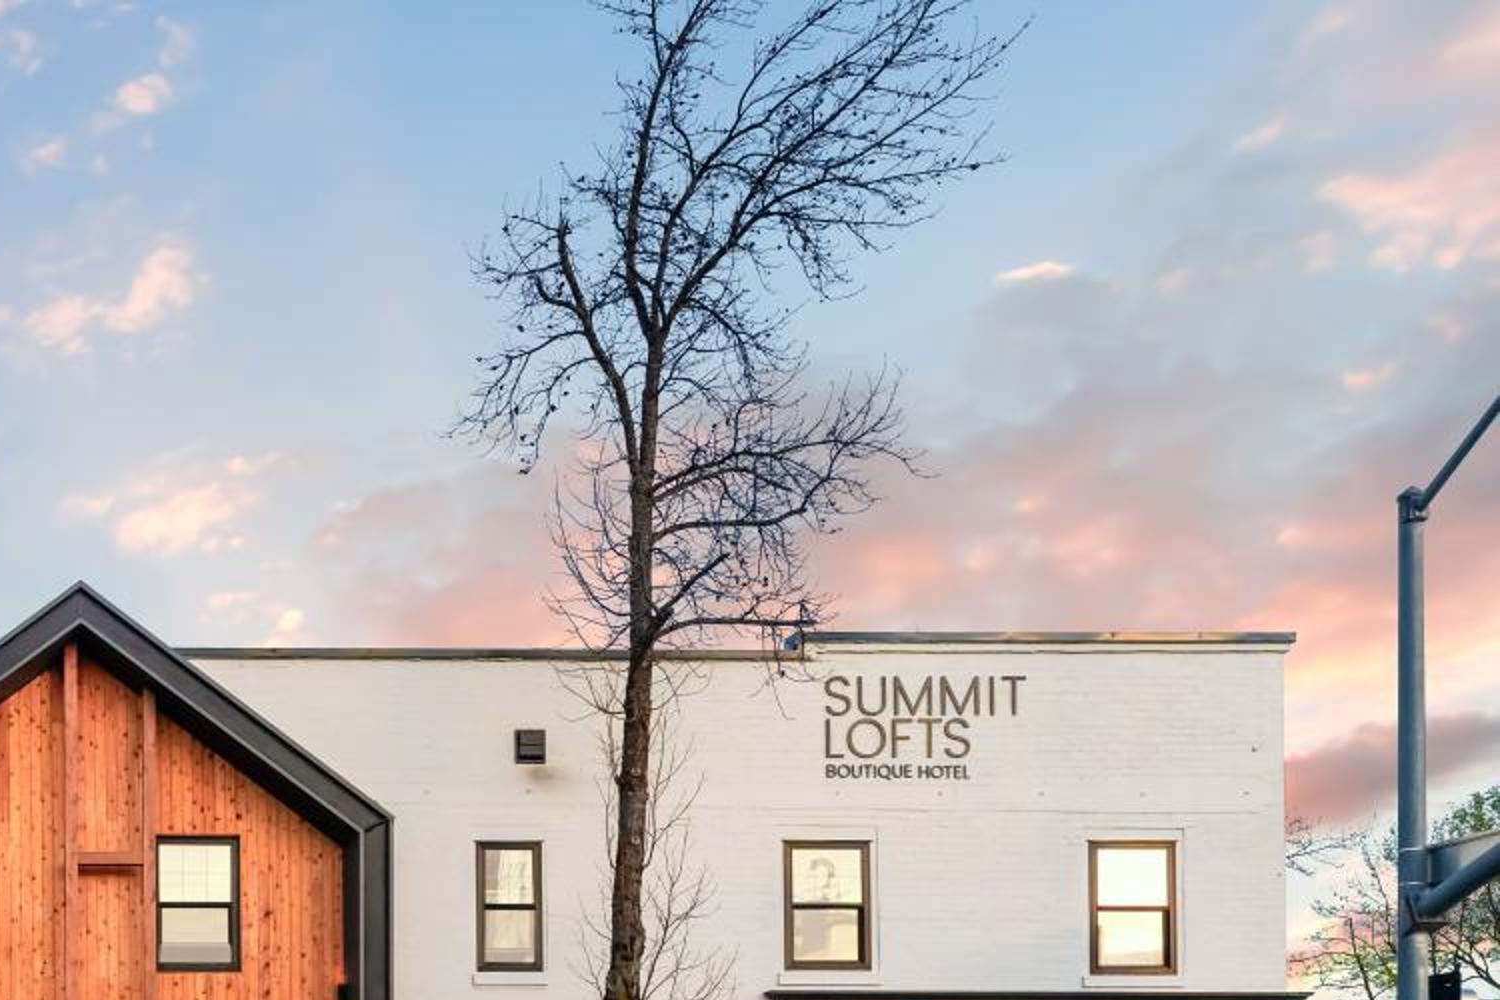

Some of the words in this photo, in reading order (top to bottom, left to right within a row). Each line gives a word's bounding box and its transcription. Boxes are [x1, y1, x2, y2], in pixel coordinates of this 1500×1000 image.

[824, 675, 1027, 717] SUMMIT
[824, 718, 971, 759] LOFTS
[825, 764, 913, 780] BOUTIQUE
[917, 764, 971, 780] HOTEL
